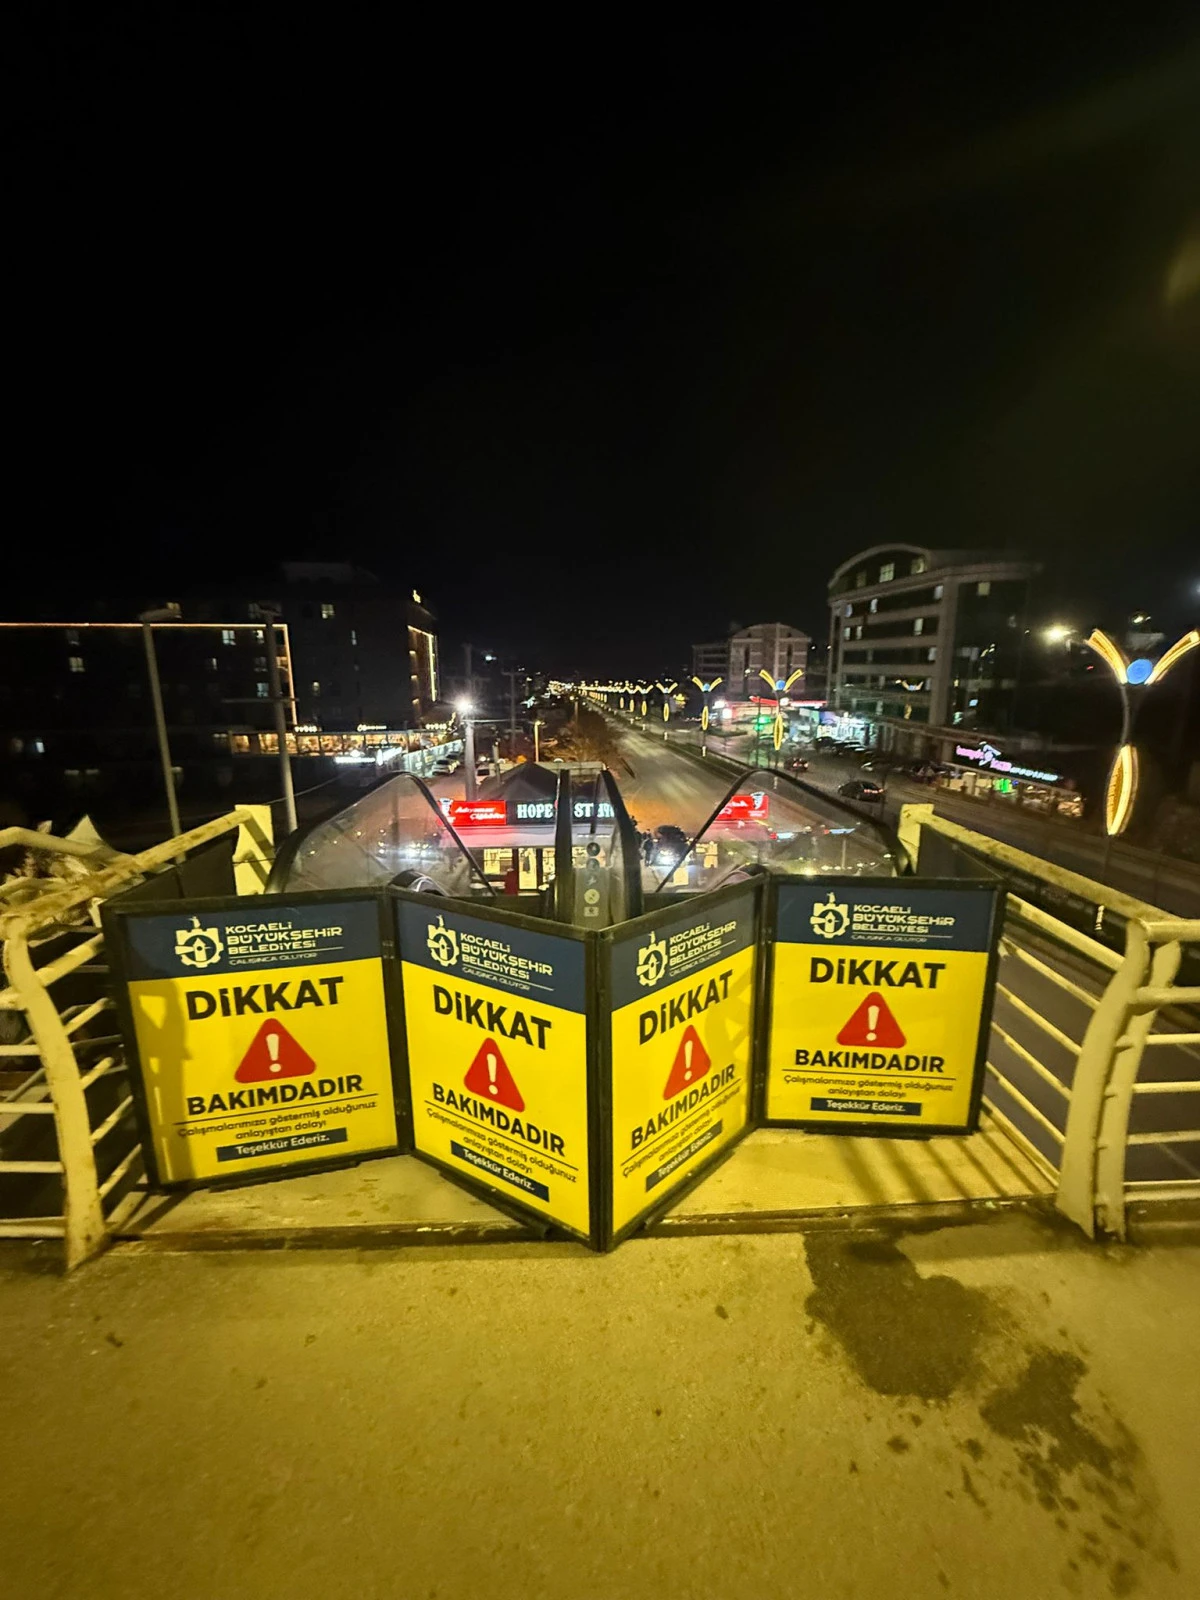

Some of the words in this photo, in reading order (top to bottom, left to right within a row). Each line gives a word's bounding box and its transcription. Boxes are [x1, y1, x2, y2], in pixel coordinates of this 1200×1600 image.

[517, 803, 553, 818] HOPE
[795, 1049, 944, 1073] BAKIMDADIR
[187, 1074, 363, 1115] BAKIMDADIR
[323, 1101, 376, 1114] olduğunuz
[631, 1063, 735, 1150] BAKIMDADIR
[295, 1119, 326, 1131] dolayı
[432, 1082, 565, 1157] BAKIMDADIR
[236, 1137, 288, 1155] Teşekkür
[291, 1132, 330, 1147] Ederiz.
